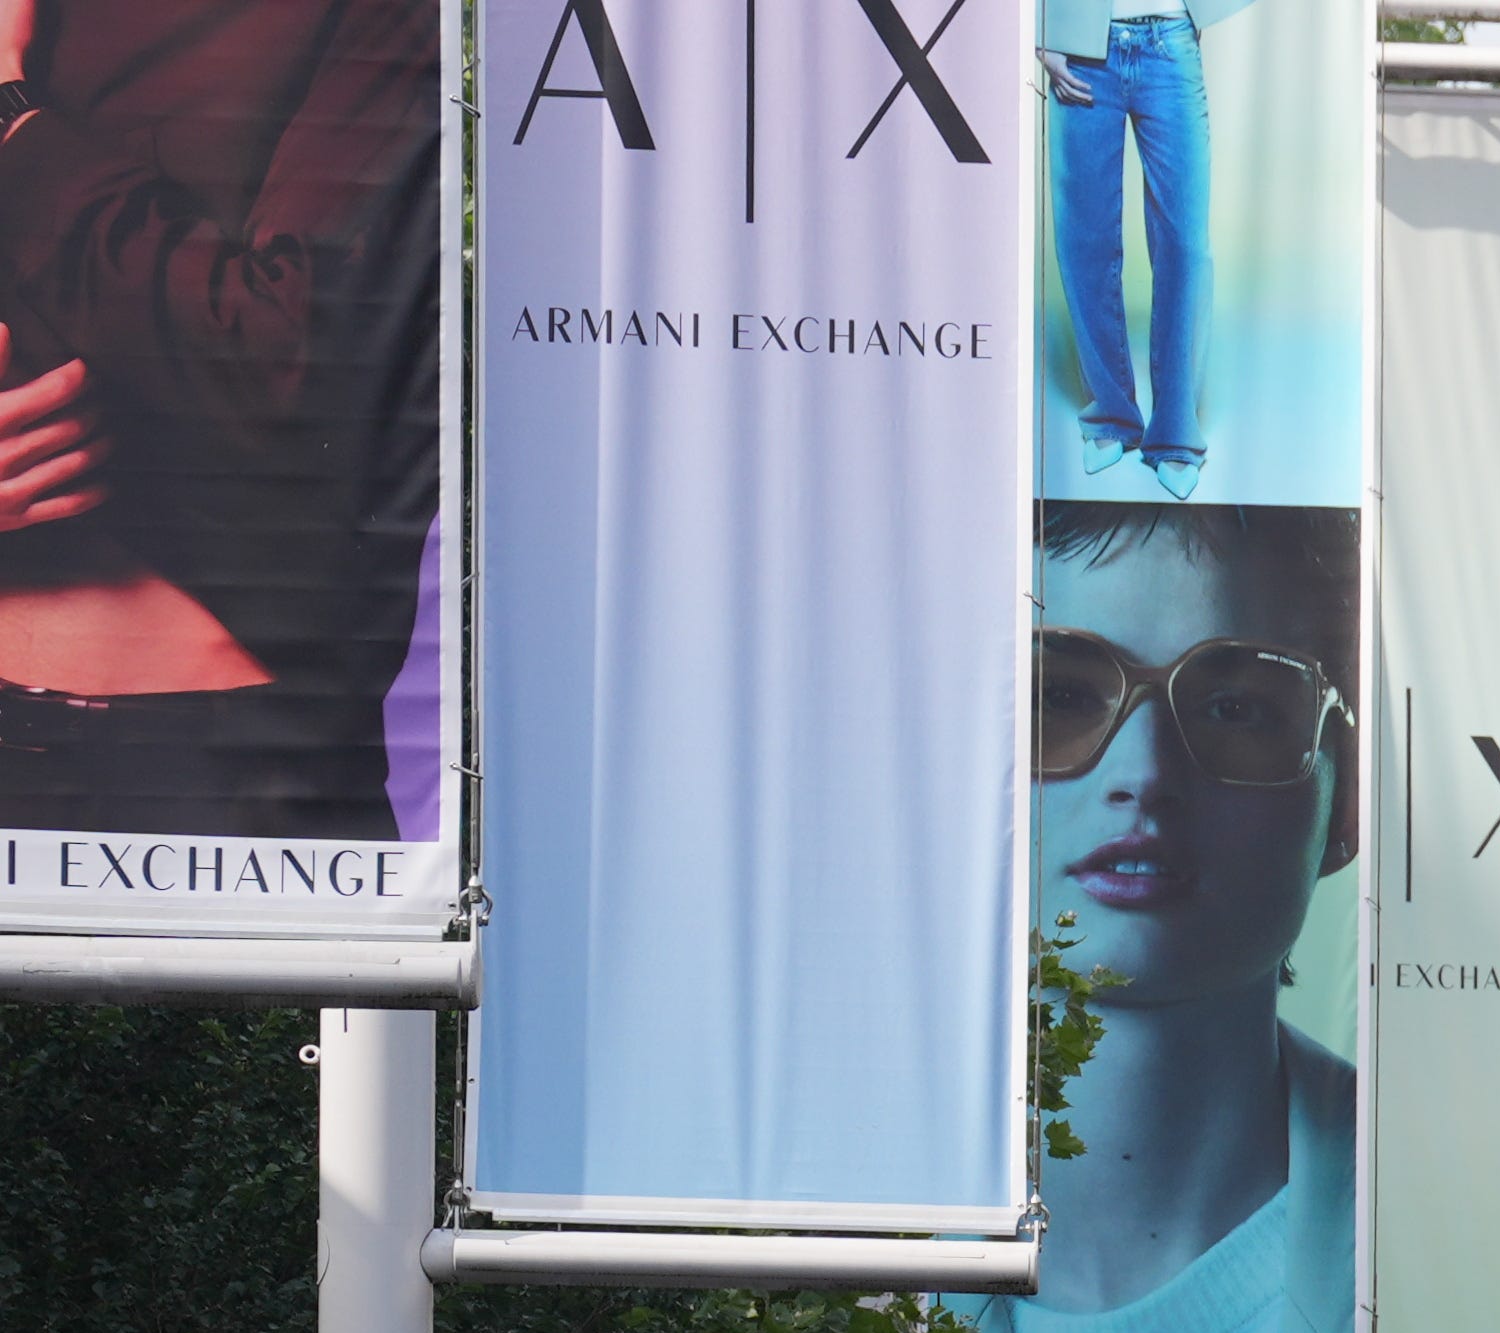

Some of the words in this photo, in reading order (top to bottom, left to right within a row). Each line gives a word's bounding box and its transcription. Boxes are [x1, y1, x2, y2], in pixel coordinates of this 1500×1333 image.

[512, 306, 701, 349] ARMANI
[732, 314, 994, 360] EXCHANGE
[62, 842, 406, 898] EXCHANGE
